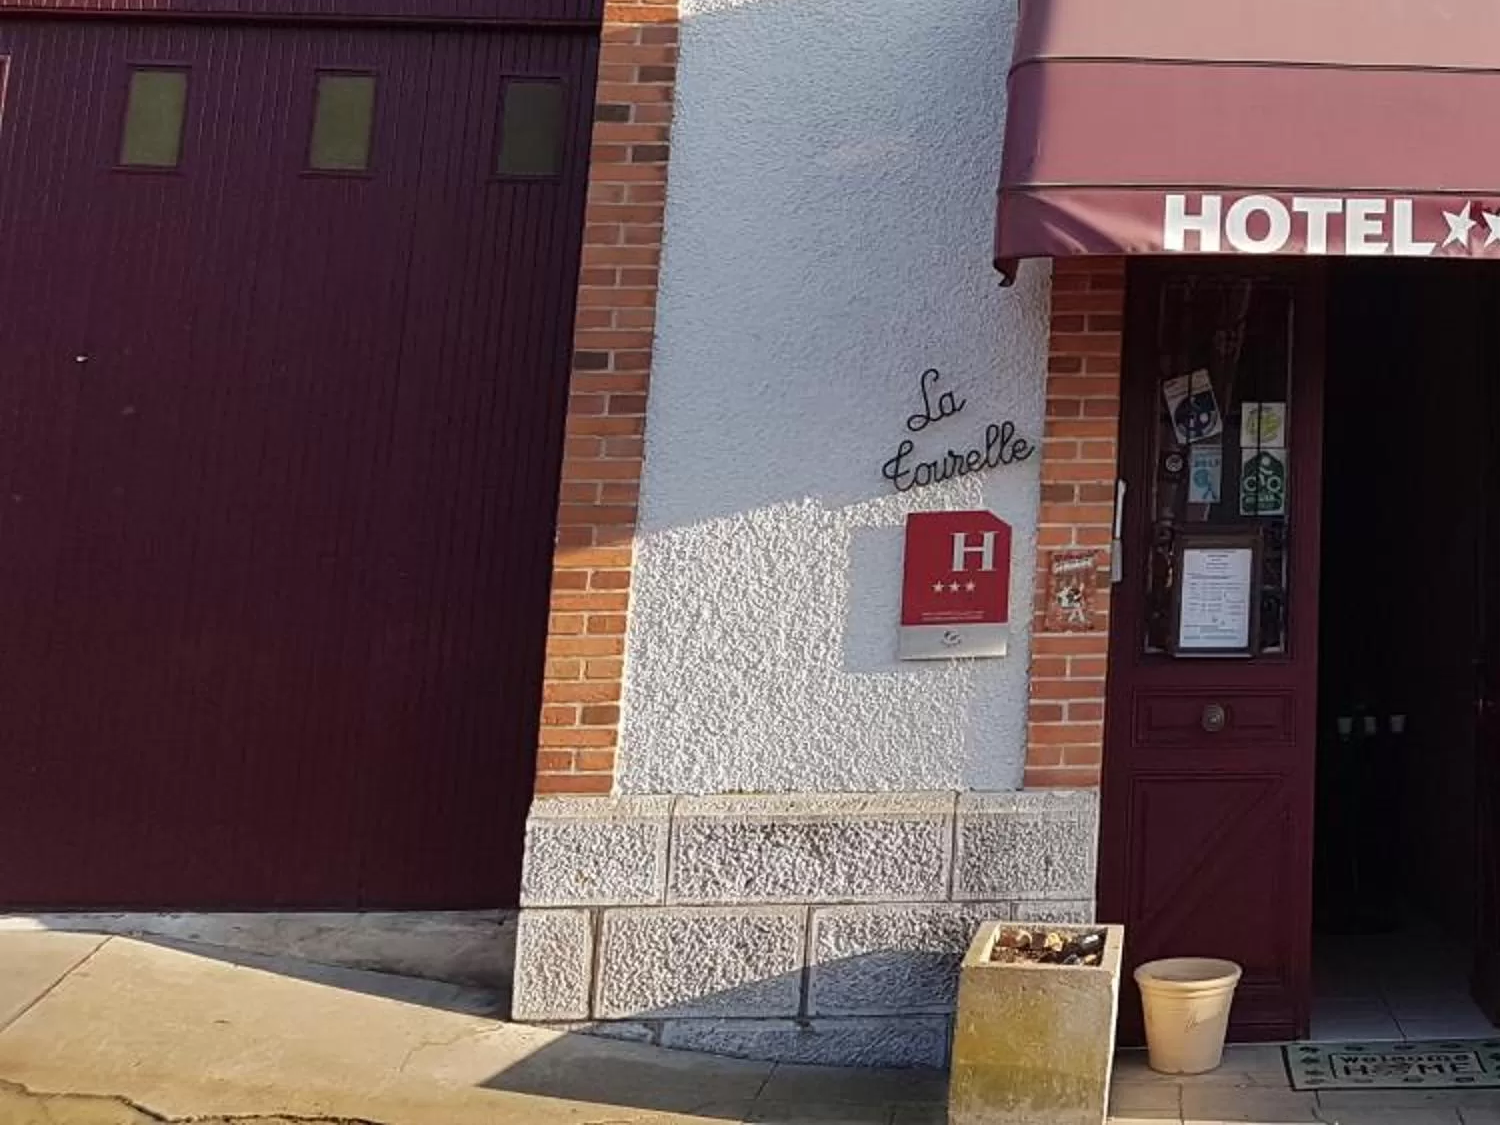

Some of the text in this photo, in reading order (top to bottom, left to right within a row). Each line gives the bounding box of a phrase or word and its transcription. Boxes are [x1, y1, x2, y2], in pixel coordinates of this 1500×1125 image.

[1163, 194, 1436, 255] HOTEL
[906, 368, 966, 432] La
[882, 421, 1035, 492] Tourelle
[951, 530, 999, 572] H
